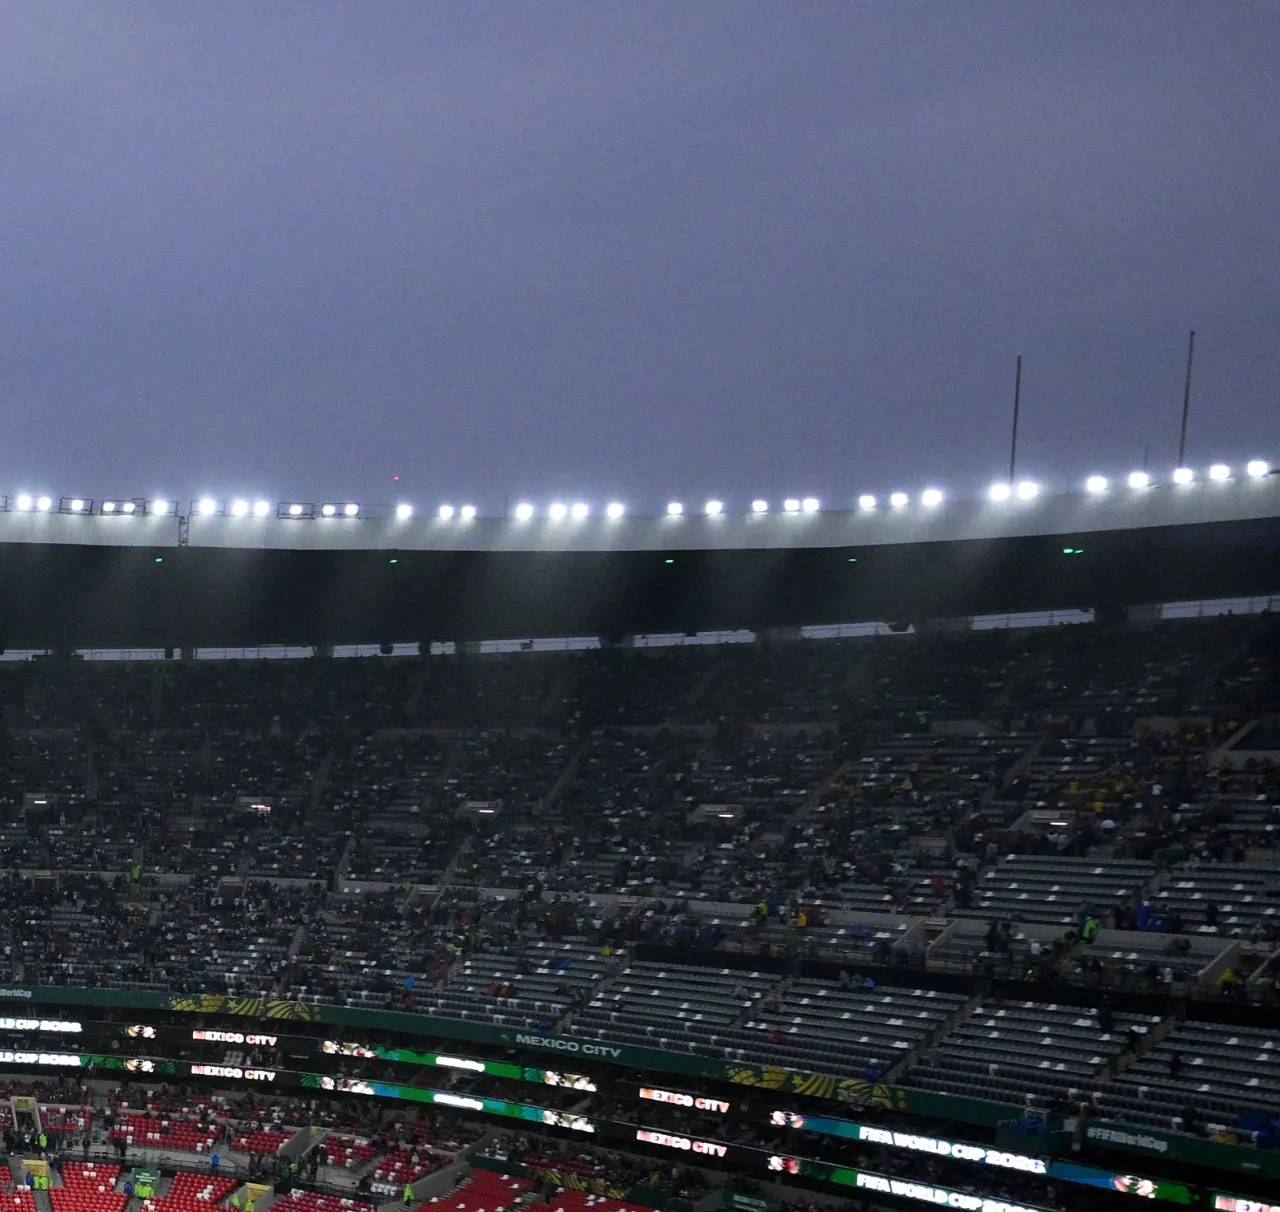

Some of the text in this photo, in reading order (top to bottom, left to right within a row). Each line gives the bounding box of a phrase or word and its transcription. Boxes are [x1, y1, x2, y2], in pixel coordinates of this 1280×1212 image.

[15, 1019, 39, 1031] CUP
[193, 1030, 244, 1043] MEXICO
[516, 1033, 621, 1058] MEXICO CITY
[15, 1052, 38, 1063] CUP
[191, 1065, 243, 1078] MEXICO
[639, 1087, 694, 1107] MEXICO
[636, 1130, 691, 1150] MEXICO
[859, 1126, 1047, 1175] FIFA WORLD CUP 2026
[856, 1174, 890, 1194] FIFA
[890, 1180, 947, 1204] WORLD
[947, 1191, 982, 1210] CUP
